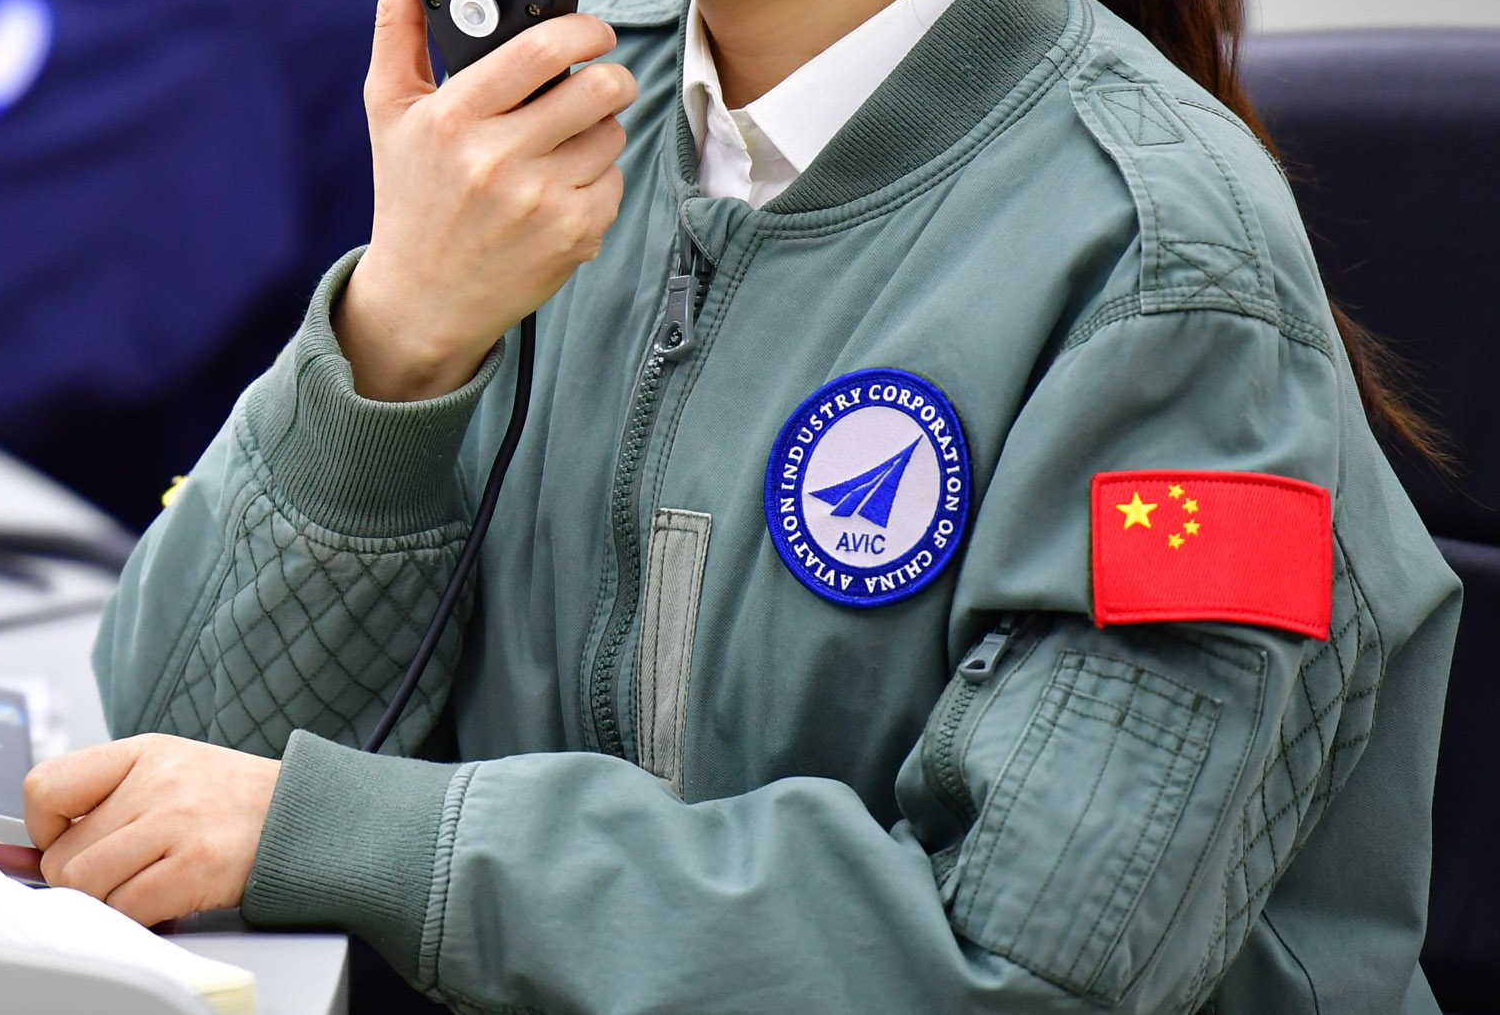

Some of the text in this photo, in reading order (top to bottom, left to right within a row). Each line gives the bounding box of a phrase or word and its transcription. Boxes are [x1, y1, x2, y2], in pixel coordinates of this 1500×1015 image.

[780, 384, 962, 594] AVIATION INDUSTRY CORPORATION OF CHINA
[835, 532, 887, 555] AVIC
